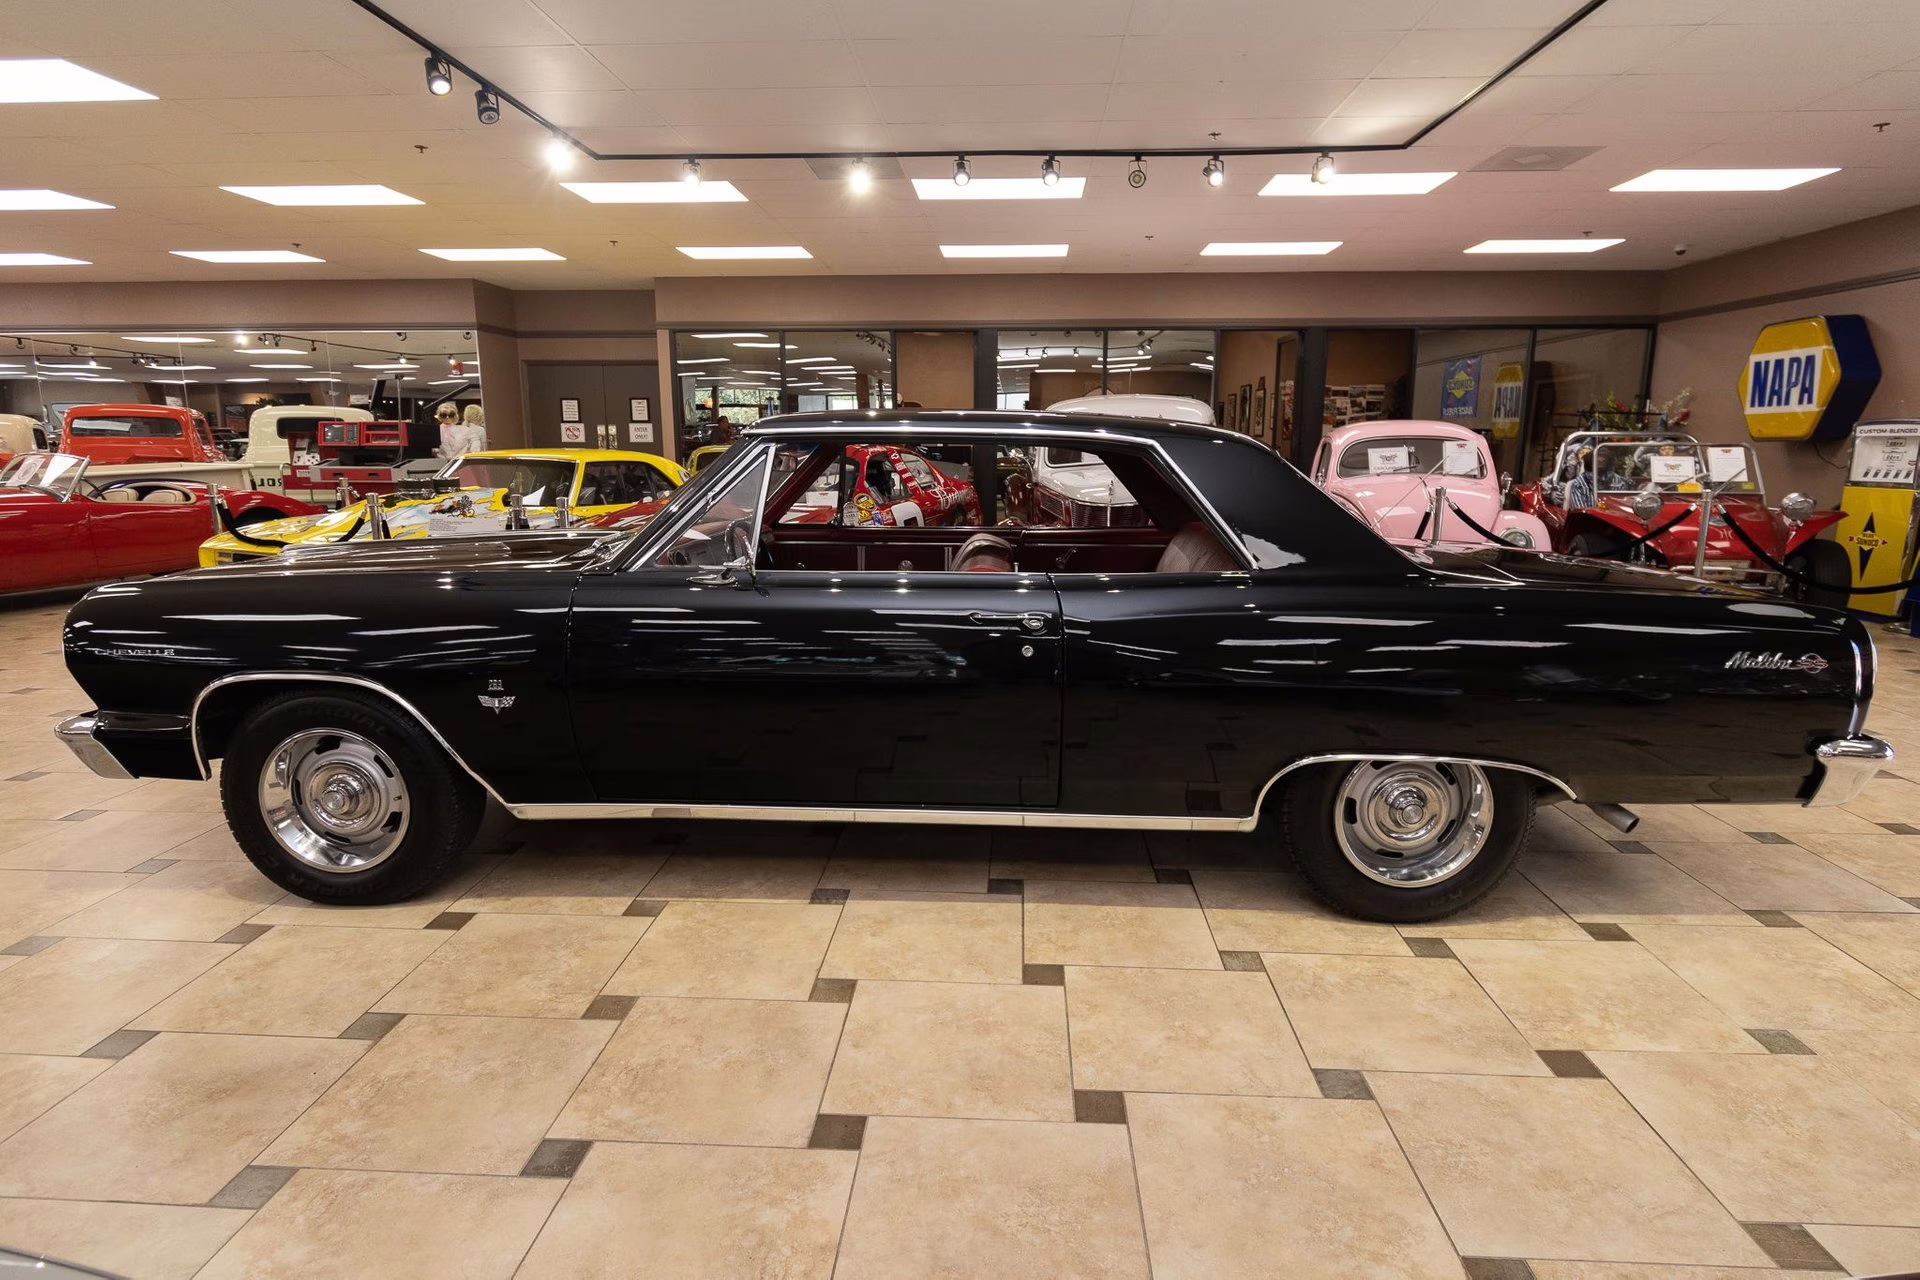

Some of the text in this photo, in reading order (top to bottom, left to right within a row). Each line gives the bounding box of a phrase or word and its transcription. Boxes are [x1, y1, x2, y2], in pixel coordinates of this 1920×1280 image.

[1750, 355, 1816, 408] NAPA
[94, 648, 175, 656] CHEVELLE
[1724, 651, 1802, 670] Malibu
